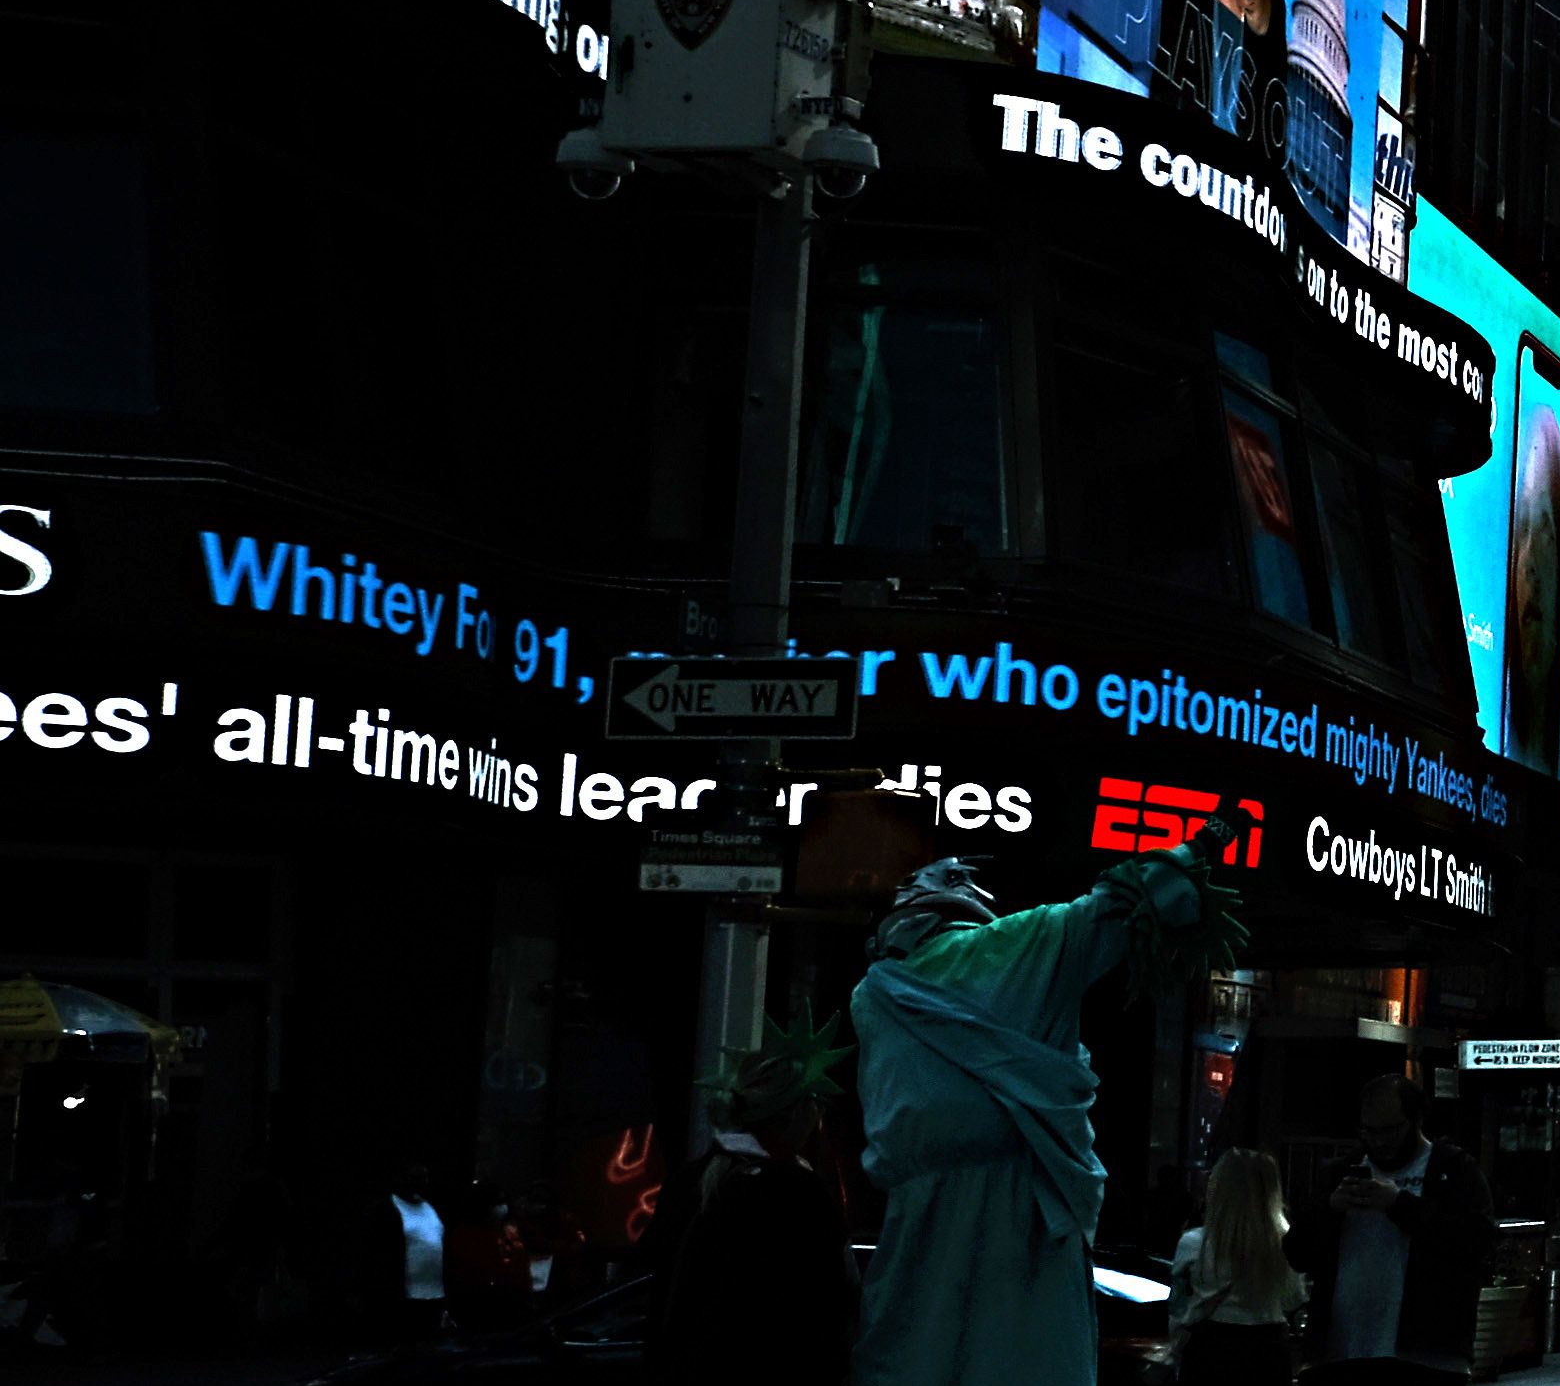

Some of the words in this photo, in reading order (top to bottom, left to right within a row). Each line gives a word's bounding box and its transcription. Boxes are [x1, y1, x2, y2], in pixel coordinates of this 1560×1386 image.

[990, 91, 1126, 172] The
[1306, 258, 1326, 309] on
[1328, 268, 1350, 325] to
[1354, 288, 1391, 351] the
[1397, 321, 1459, 388] most
[198, 529, 446, 658] Whitey
[212, 693, 460, 792] all-time
[469, 738, 539, 813] wins
[648, 684, 717, 713] ONE
[750, 684, 825, 713] WAY
[922, 642, 1079, 708] who
[1096, 674, 1317, 761] epitomized
[1325, 718, 1400, 791] mighty
[1307, 815, 1415, 901] Cowboys
[1419, 842, 1444, 903] LT
[1445, 858, 1486, 916] Smith
